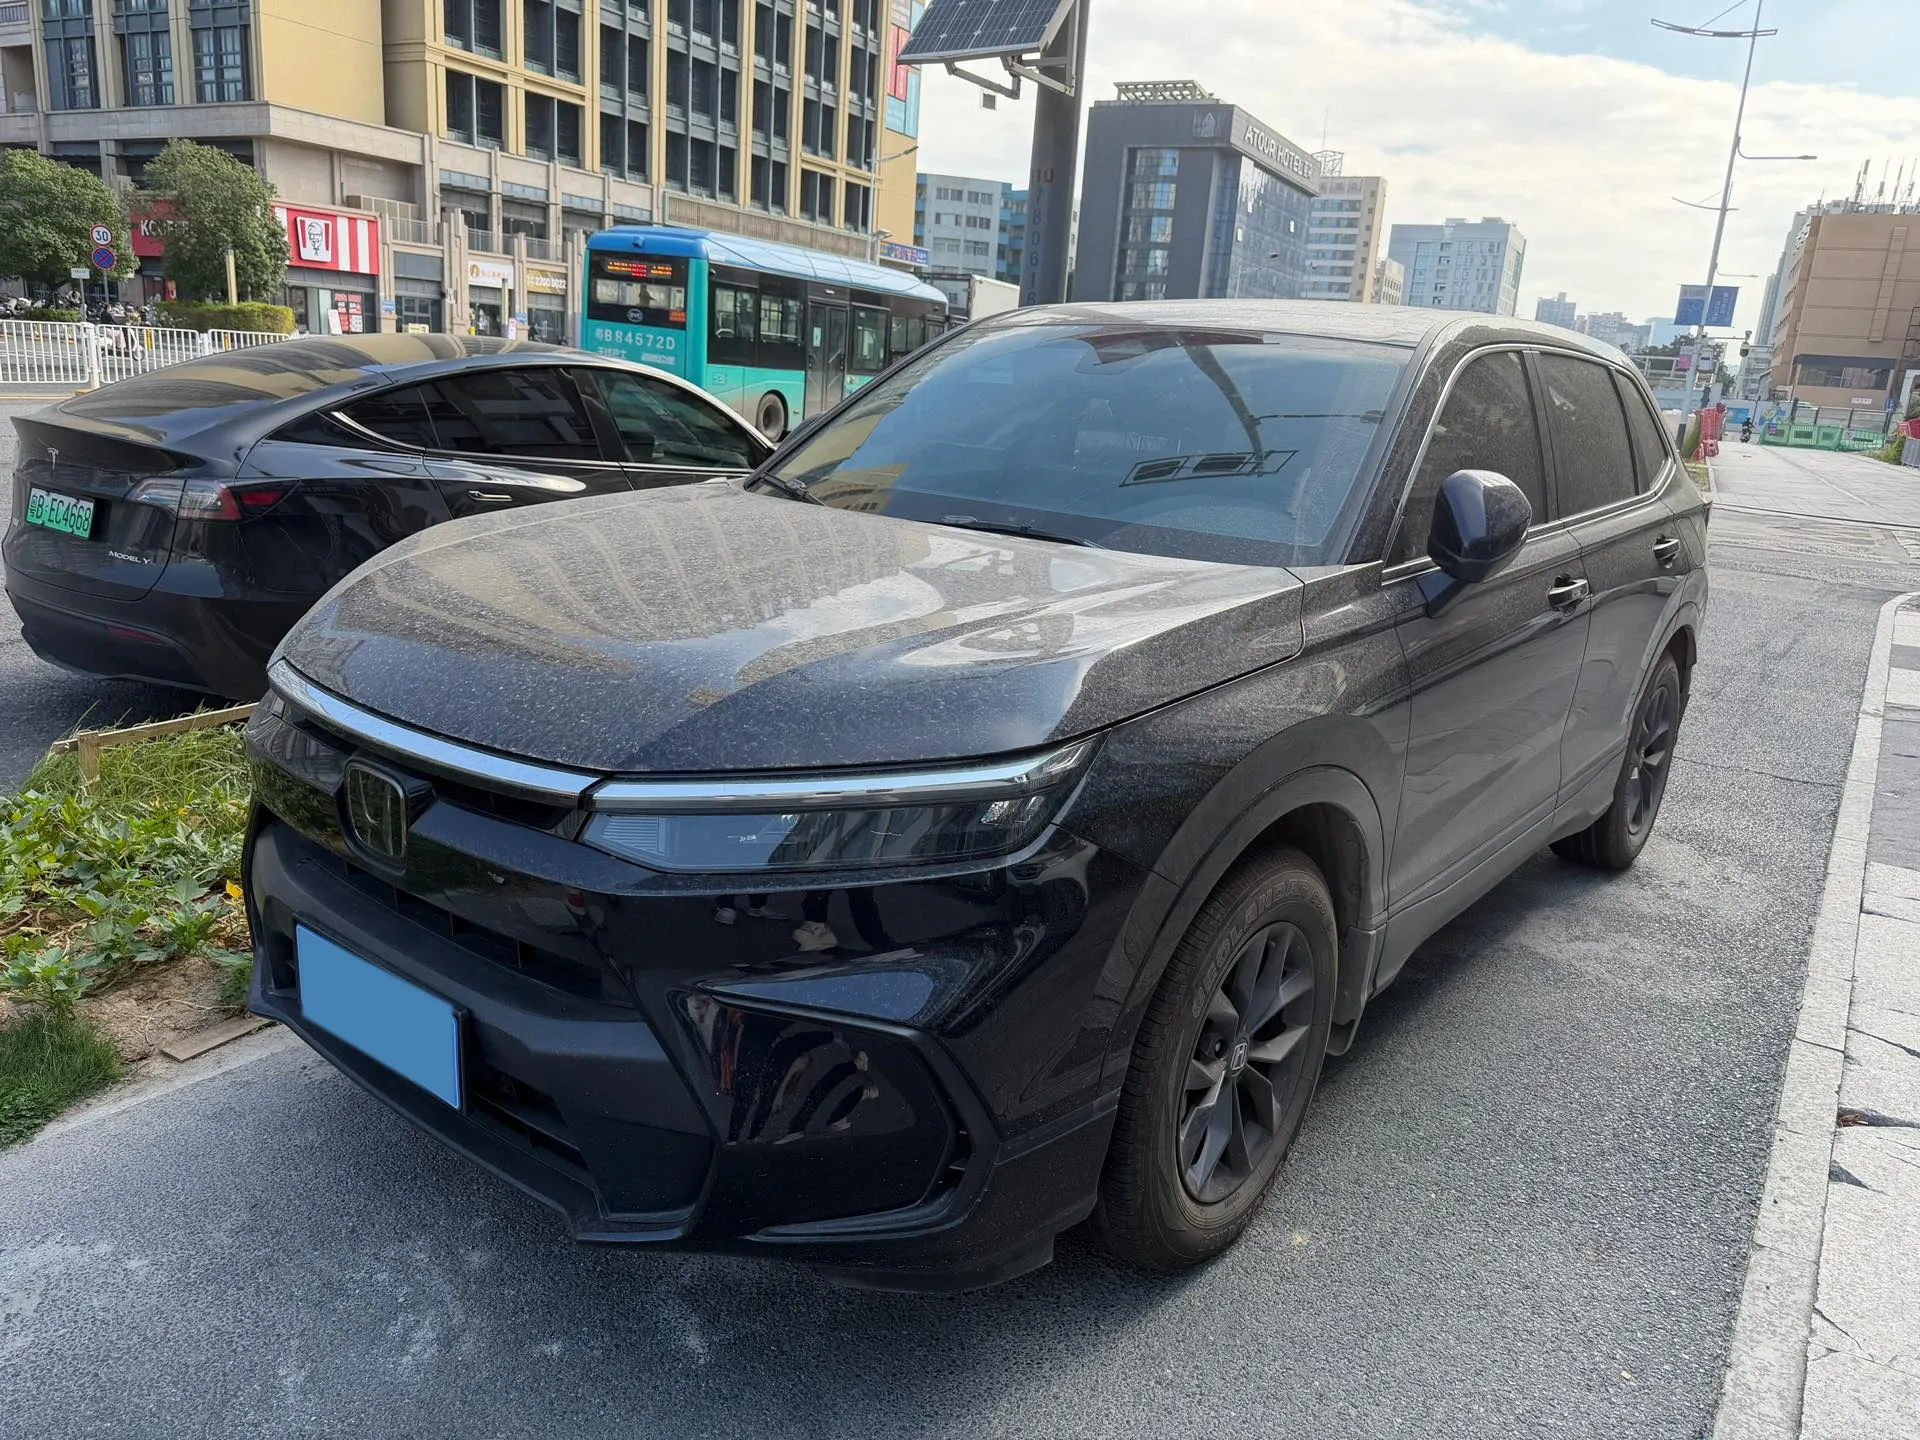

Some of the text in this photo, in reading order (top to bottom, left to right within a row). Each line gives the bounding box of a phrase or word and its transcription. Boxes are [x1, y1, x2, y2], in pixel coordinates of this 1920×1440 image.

[1244, 125, 1276, 157] ATOUR
[1277, 144, 1302, 176] HOTEL
[95, 230, 109, 242] 30
[108, 550, 152, 565] MODEL Y
